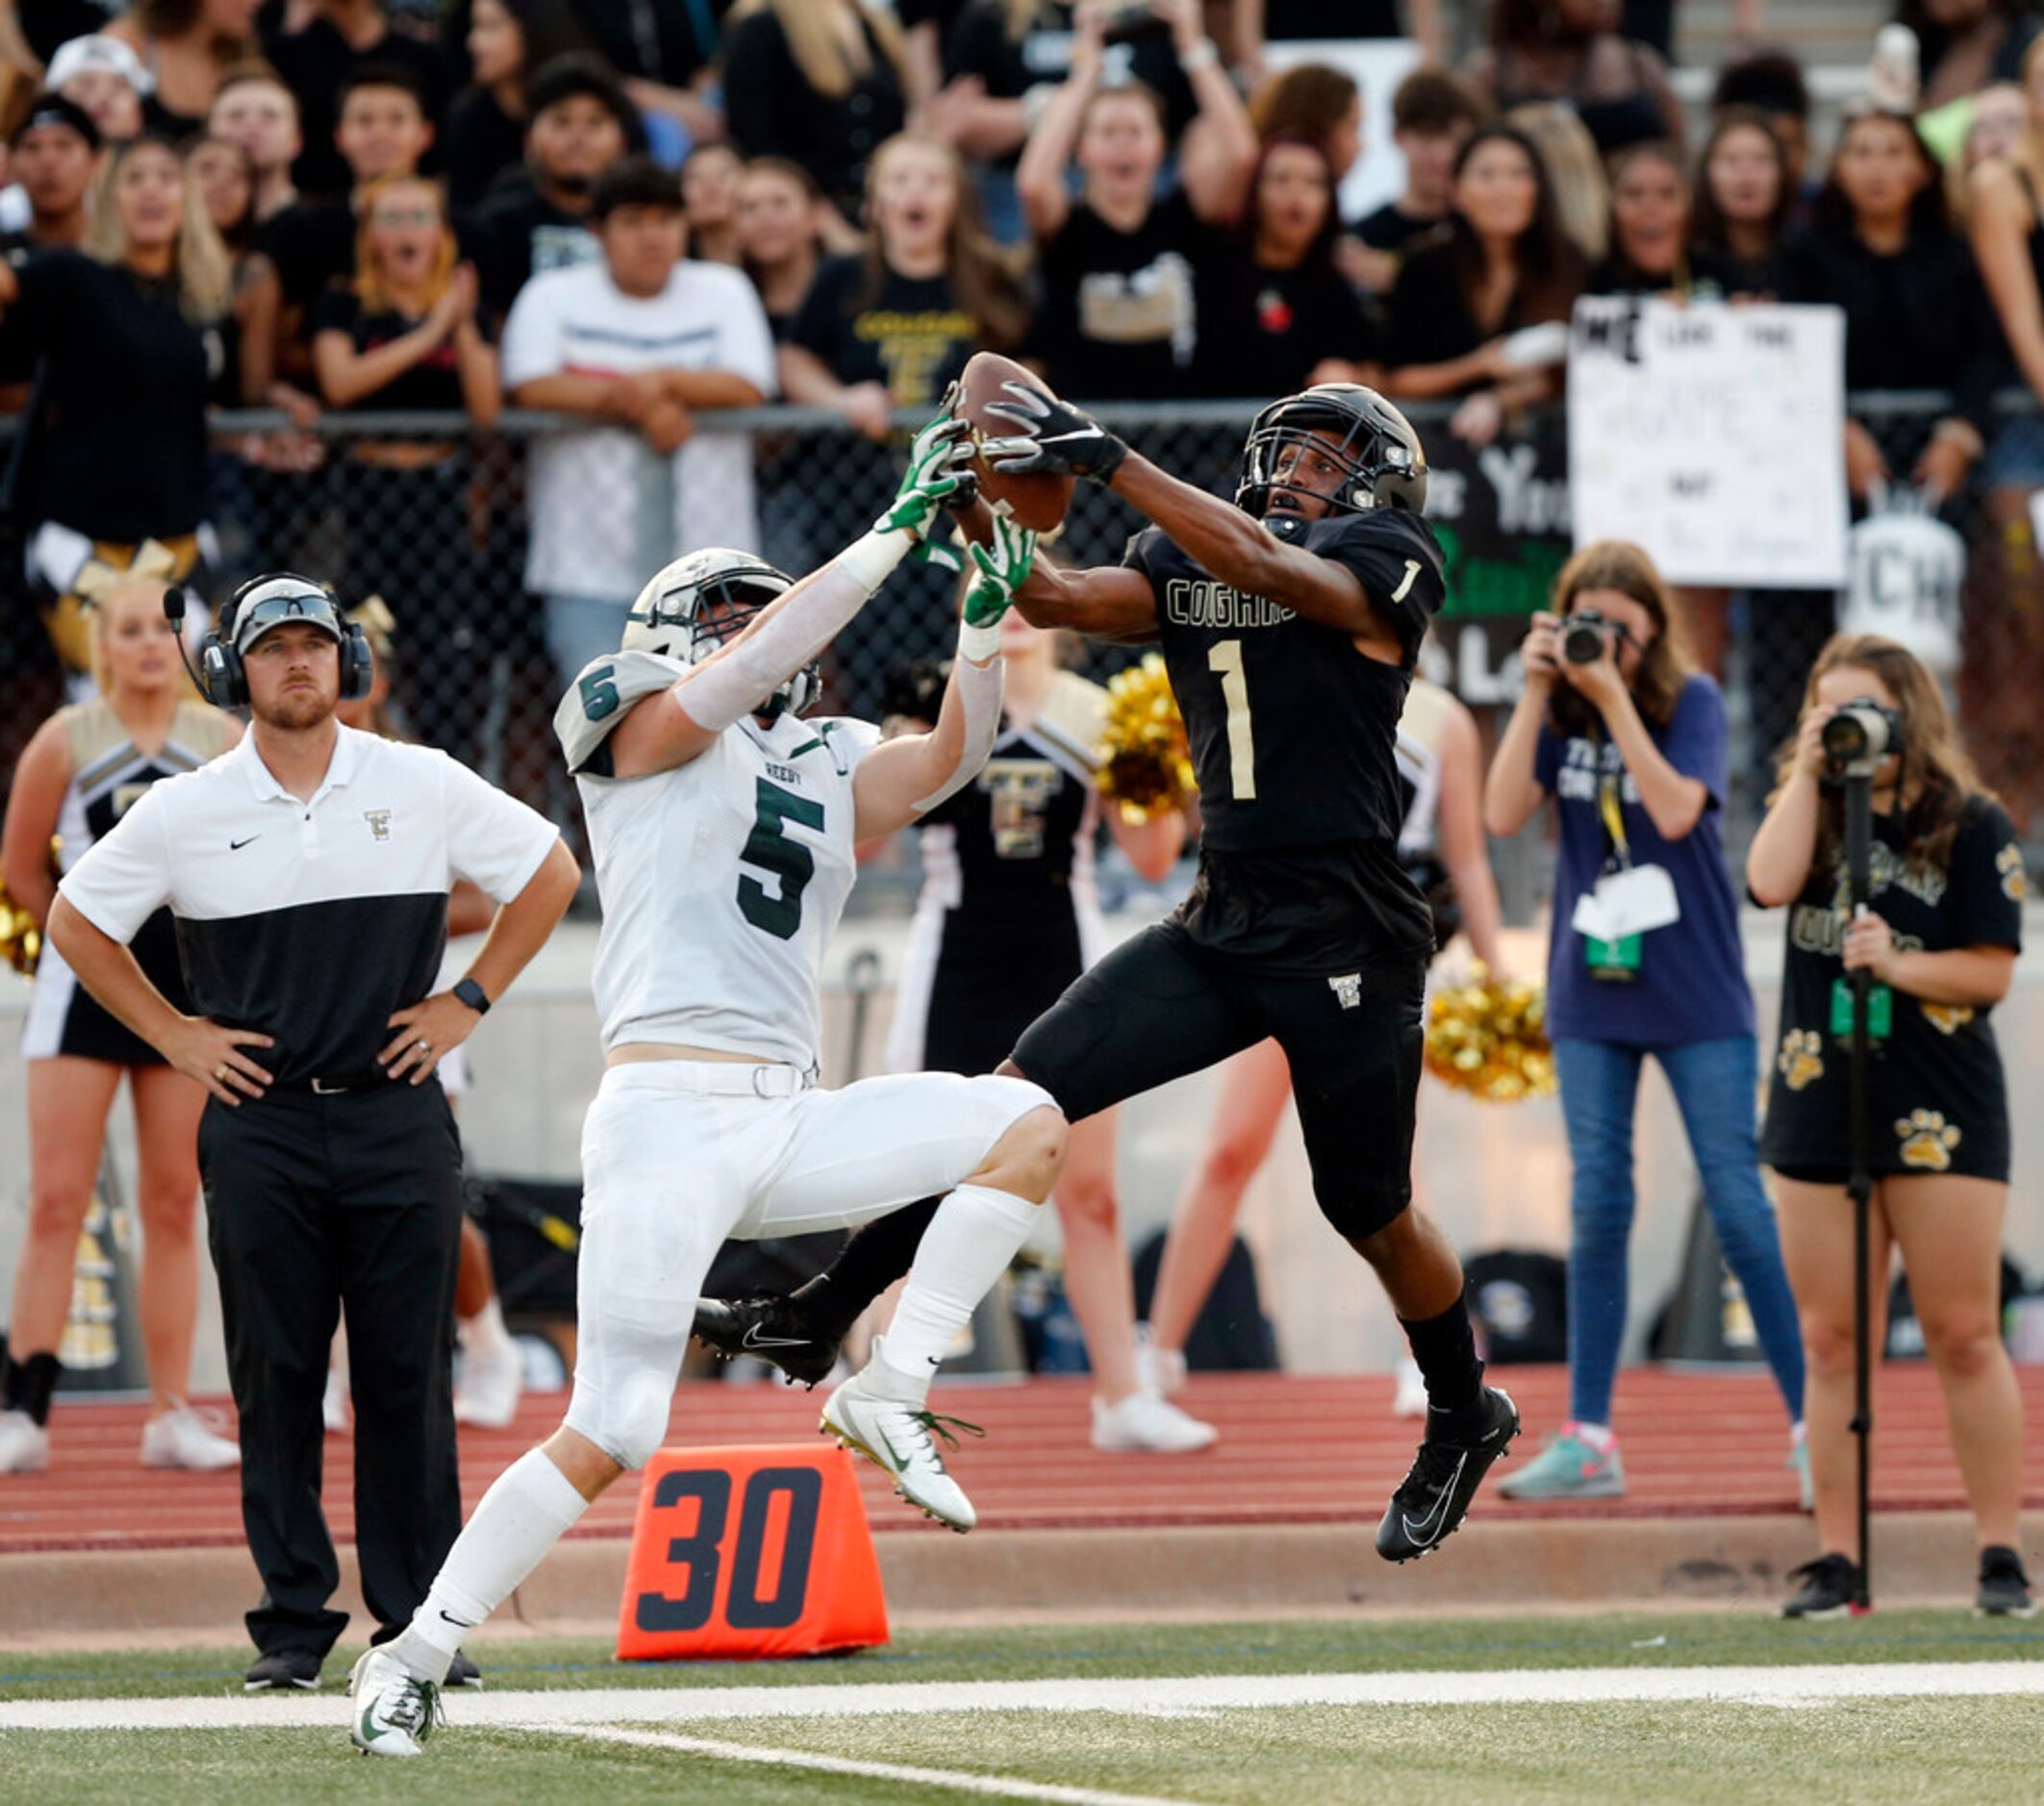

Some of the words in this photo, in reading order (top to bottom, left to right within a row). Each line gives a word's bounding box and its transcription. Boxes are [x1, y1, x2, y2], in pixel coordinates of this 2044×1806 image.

[1391, 560, 1422, 603] 1
[579, 665, 620, 722] 5
[1208, 640, 1256, 799] 1
[736, 776, 825, 941] 5
[636, 1467, 822, 1632] 30
